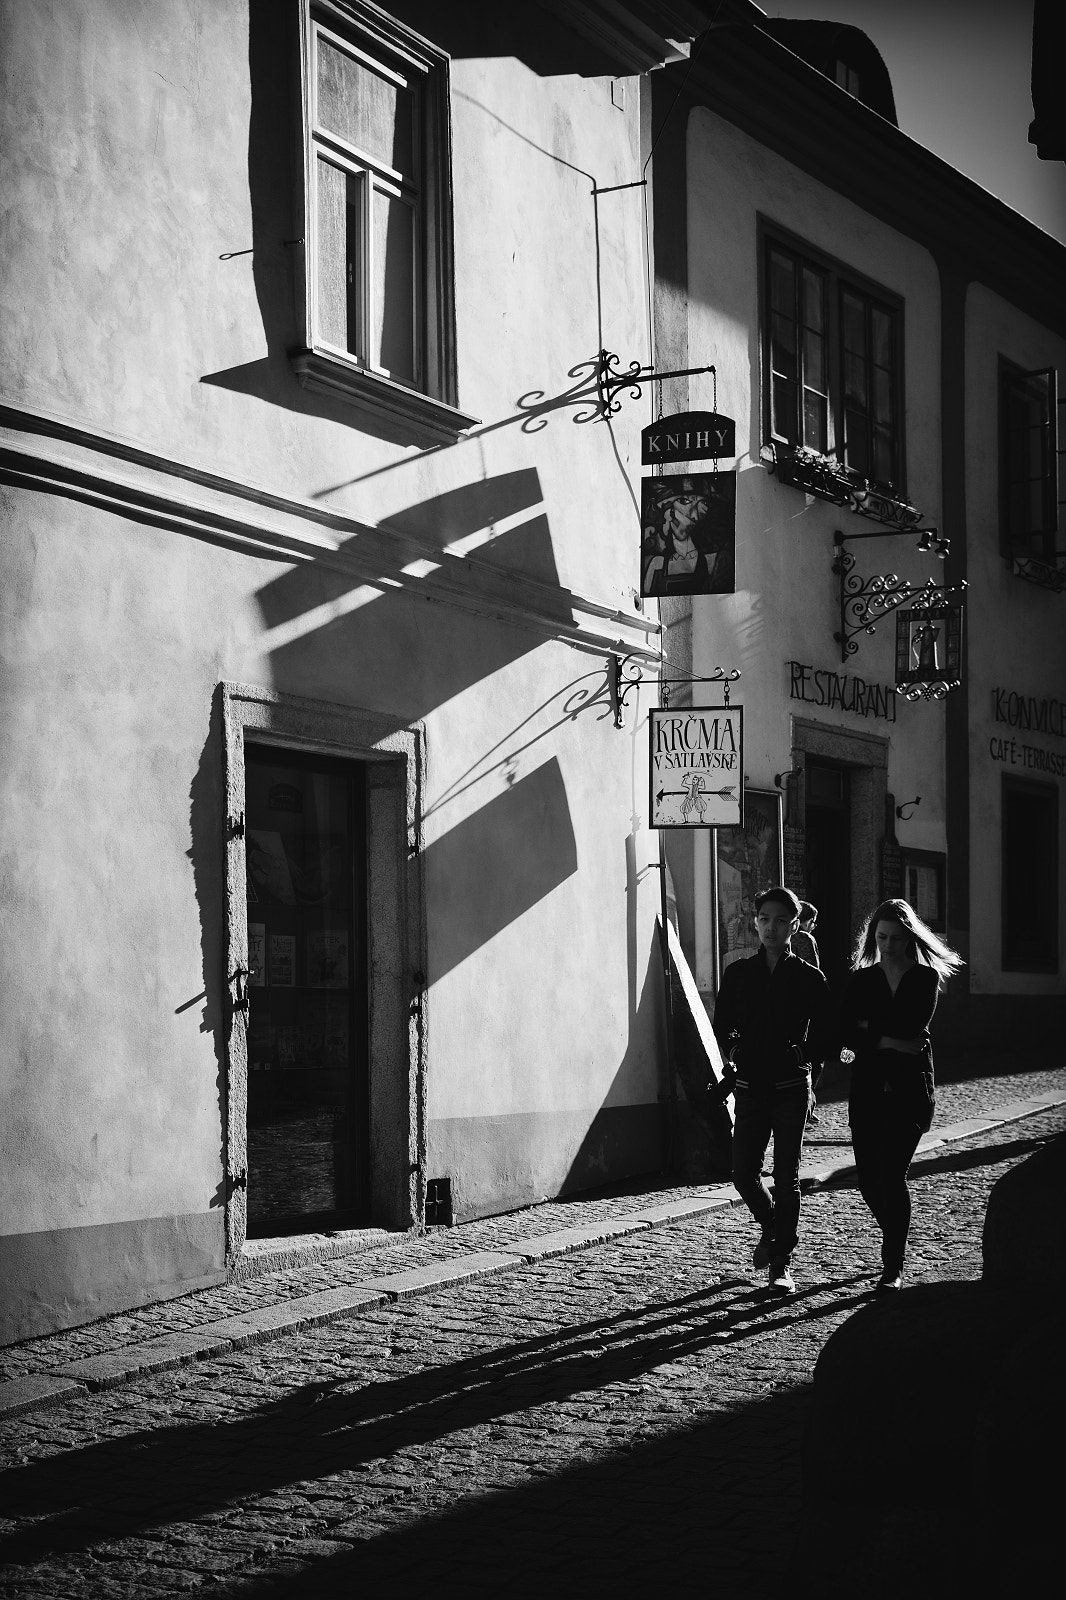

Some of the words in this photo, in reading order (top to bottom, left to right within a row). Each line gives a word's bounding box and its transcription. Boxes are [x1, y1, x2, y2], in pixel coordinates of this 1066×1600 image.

[648, 430, 728, 452] KNIHY
[785, 661, 898, 722] RESTAURANT
[656, 715, 737, 753] KRČMA
[654, 755, 663, 771] V
